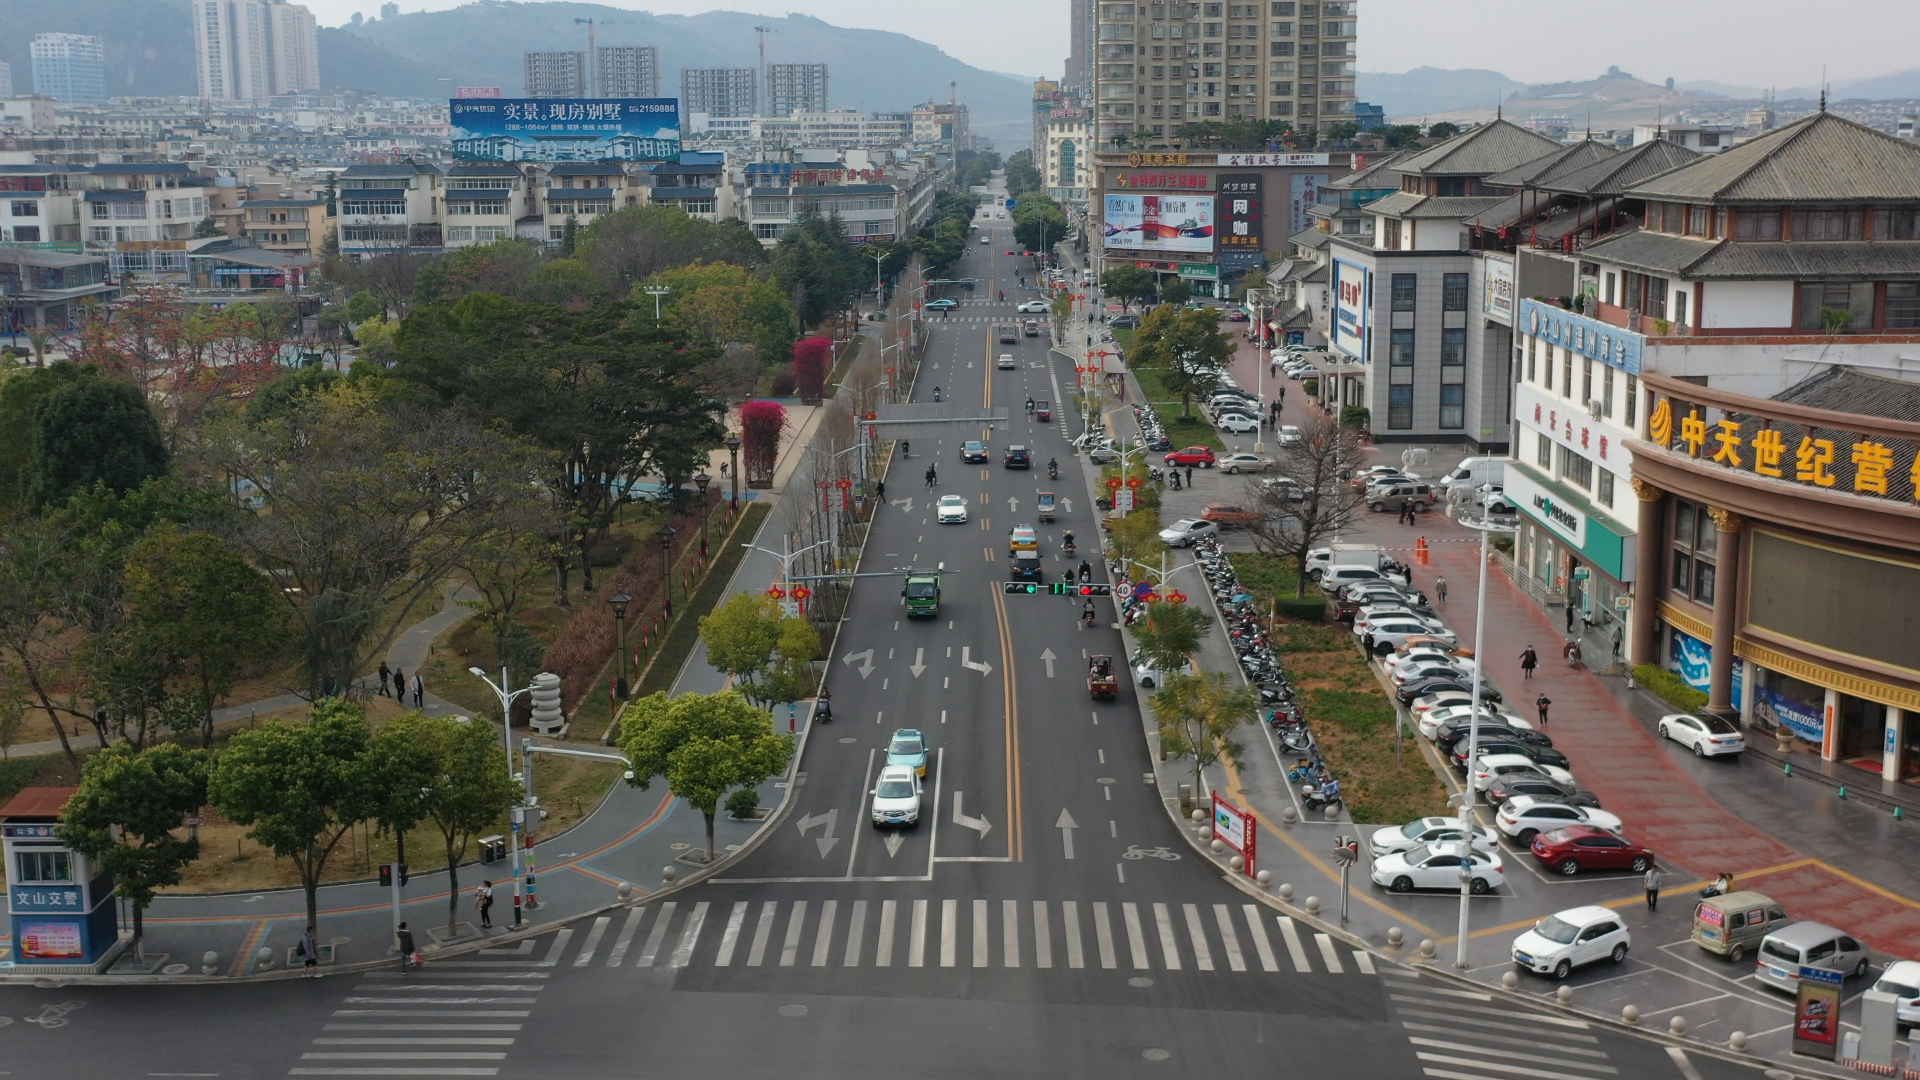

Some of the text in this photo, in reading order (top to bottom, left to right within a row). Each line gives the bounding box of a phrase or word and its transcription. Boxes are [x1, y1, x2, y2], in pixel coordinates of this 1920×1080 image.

[503, 102, 621, 121] 实景。现房别墅
[639, 104, 675, 113] 2159888
[1233, 199, 1248, 236] 网咖
[1541, 313, 1626, 365] 文山州温州商会
[1681, 409, 1920, 500] 中天世纪营
[1118, 585, 1128, 595] 40
[16, 890, 78, 906] 文山交警
